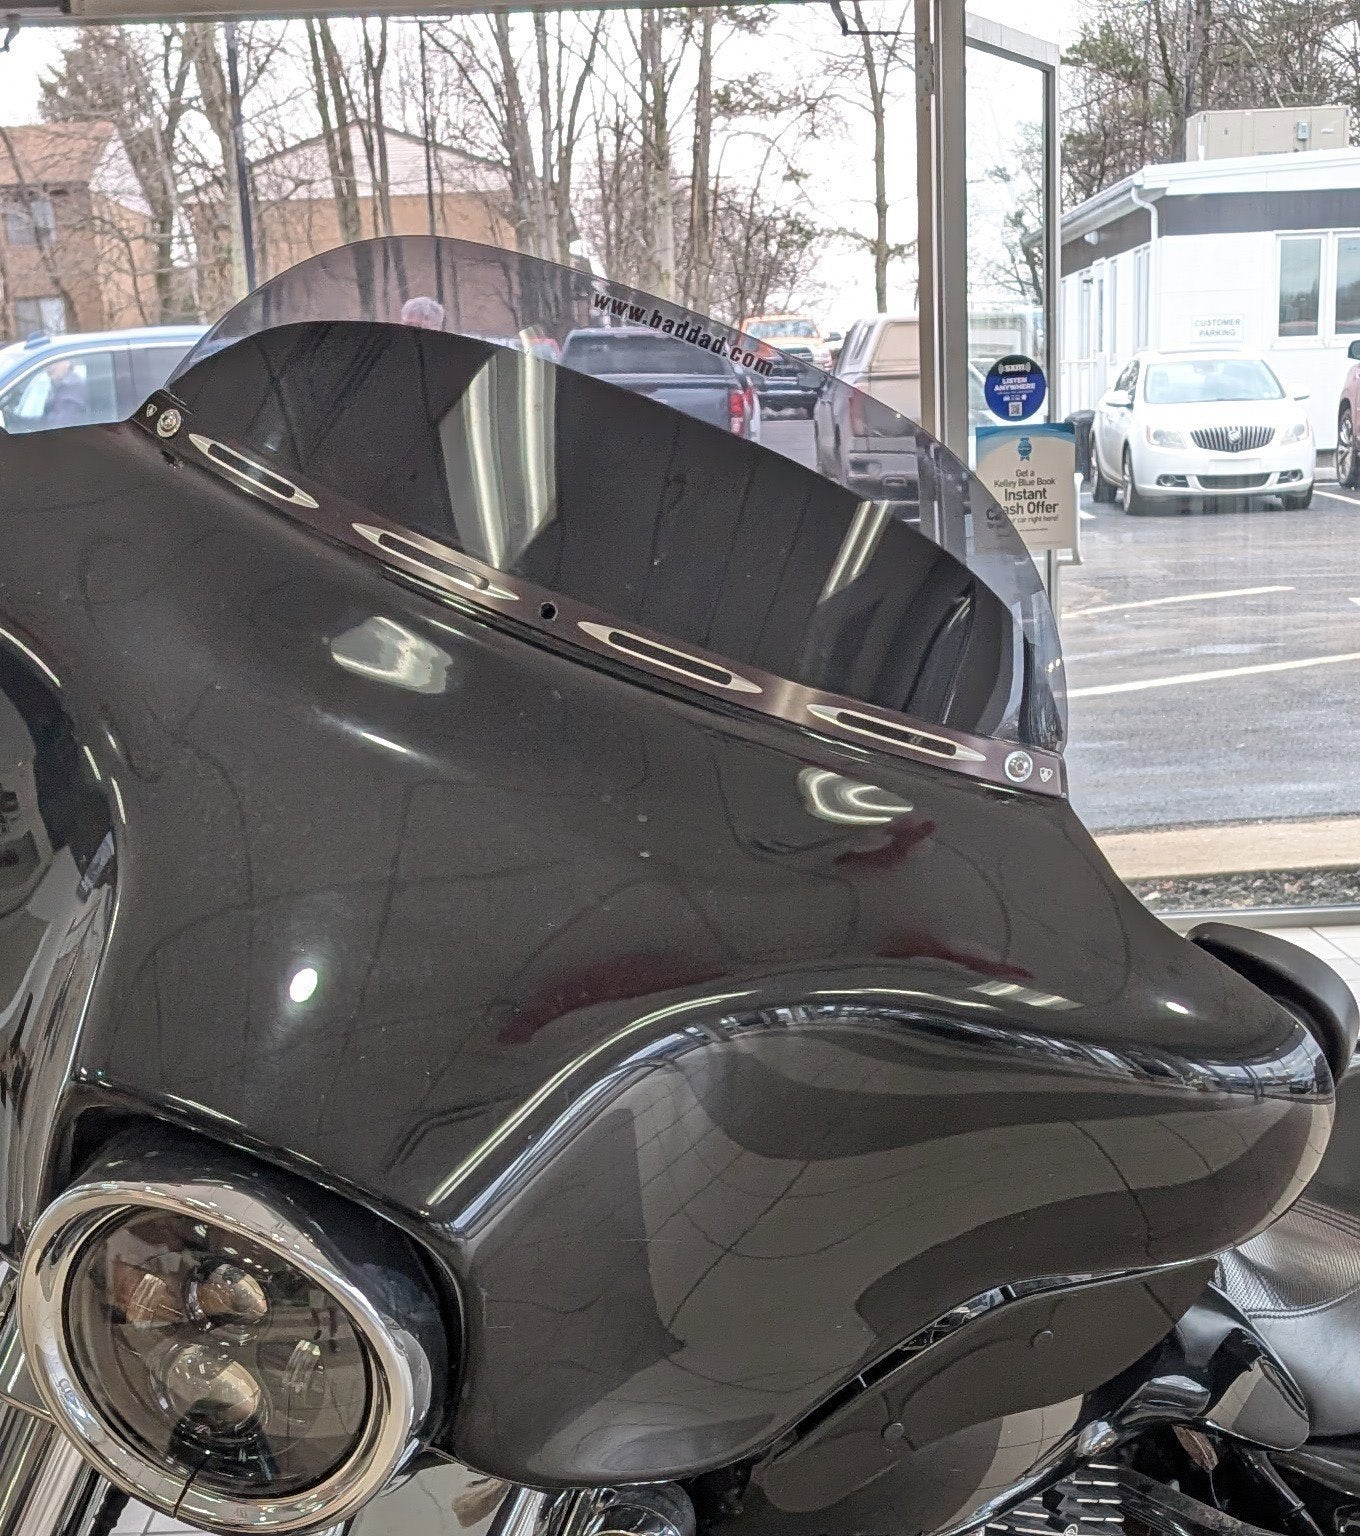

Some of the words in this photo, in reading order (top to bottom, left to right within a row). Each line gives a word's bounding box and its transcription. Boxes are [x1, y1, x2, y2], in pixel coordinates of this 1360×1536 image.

[1194, 318, 1241, 326] CUSTOMER
[594, 293, 774, 377] www.baddad.com
[1199, 329, 1236, 337] PARKING
[1015, 469, 1028, 477] Get
[994, 479, 1016, 489] Kelley
[1018, 478, 1035, 487] Blue
[1036, 478, 1056, 486] Book
[1004, 487, 1048, 501] Instant
[1027, 501, 1059, 515] Offer
